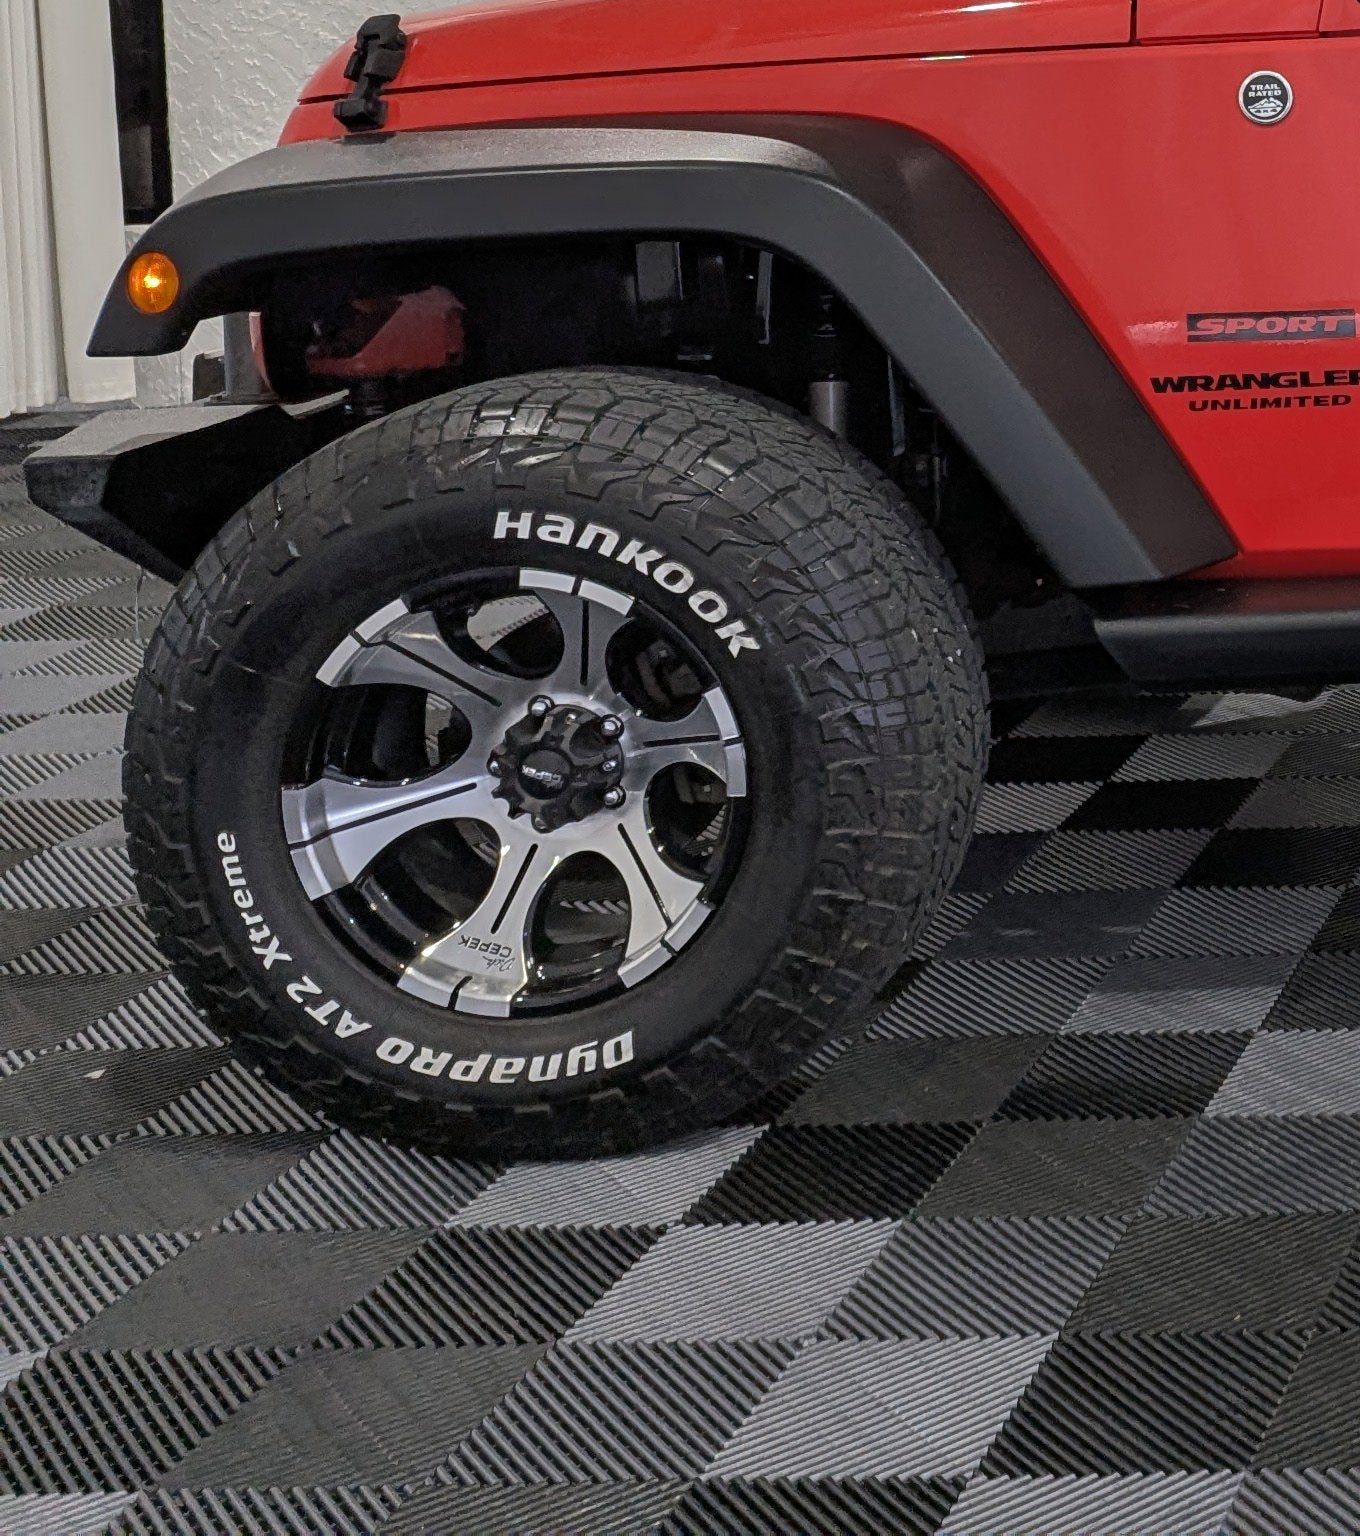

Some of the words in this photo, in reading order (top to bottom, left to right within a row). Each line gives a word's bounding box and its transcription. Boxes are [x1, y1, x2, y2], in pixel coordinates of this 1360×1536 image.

[1248, 90, 1282, 98] RATED
[1250, 83, 1281, 91] TRAIL
[1189, 315, 1356, 336] SPORT
[1188, 394, 1352, 412] UNLIMITED
[216, 831, 293, 970] Xtreme
[458, 934, 512, 958] CEPEK
[286, 974, 374, 1040] AT2
